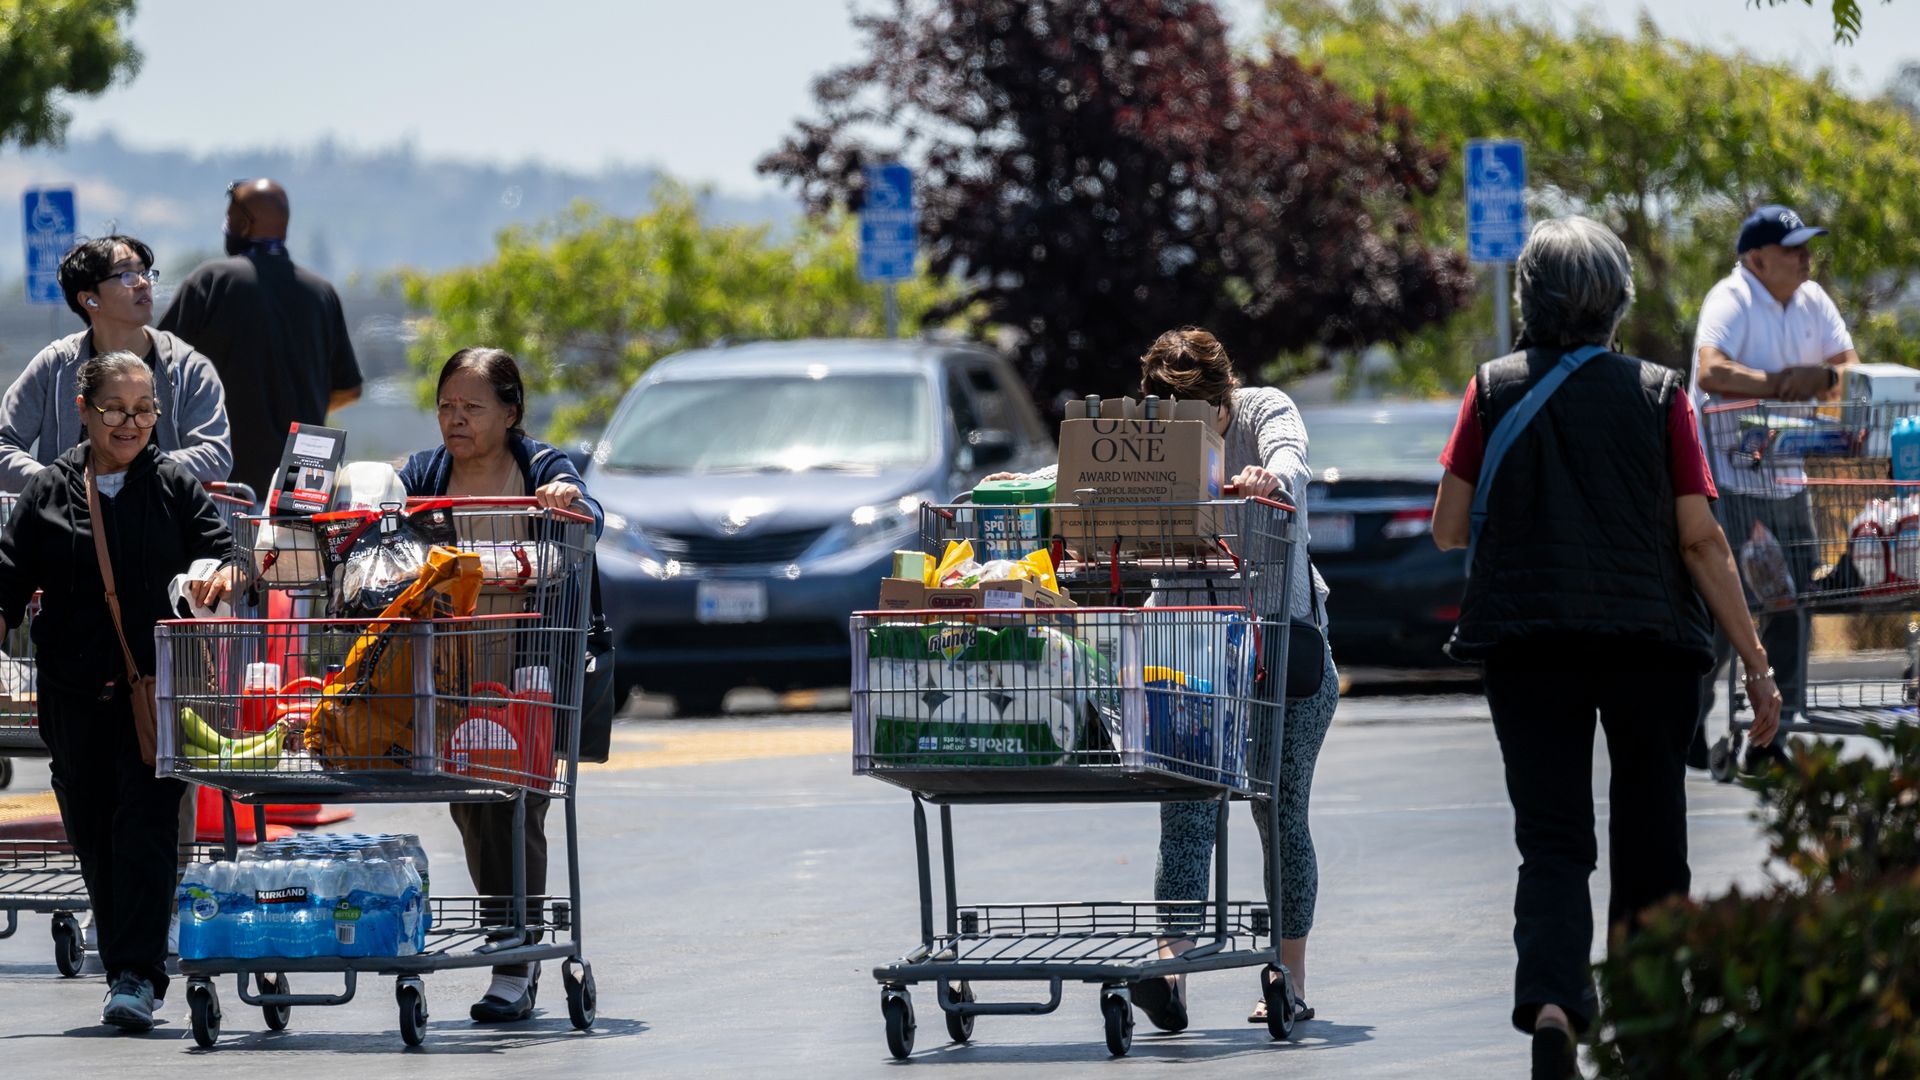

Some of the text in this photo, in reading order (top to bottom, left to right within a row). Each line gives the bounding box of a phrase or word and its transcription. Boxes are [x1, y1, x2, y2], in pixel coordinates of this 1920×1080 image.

[1091, 438, 1165, 462] ONE
[1079, 471, 1177, 482] AWARD WINNING
[1088, 486, 1167, 495] COHOL REMOVED
[928, 628, 977, 651] Bounty
[258, 888, 305, 899] KIRKLAND
